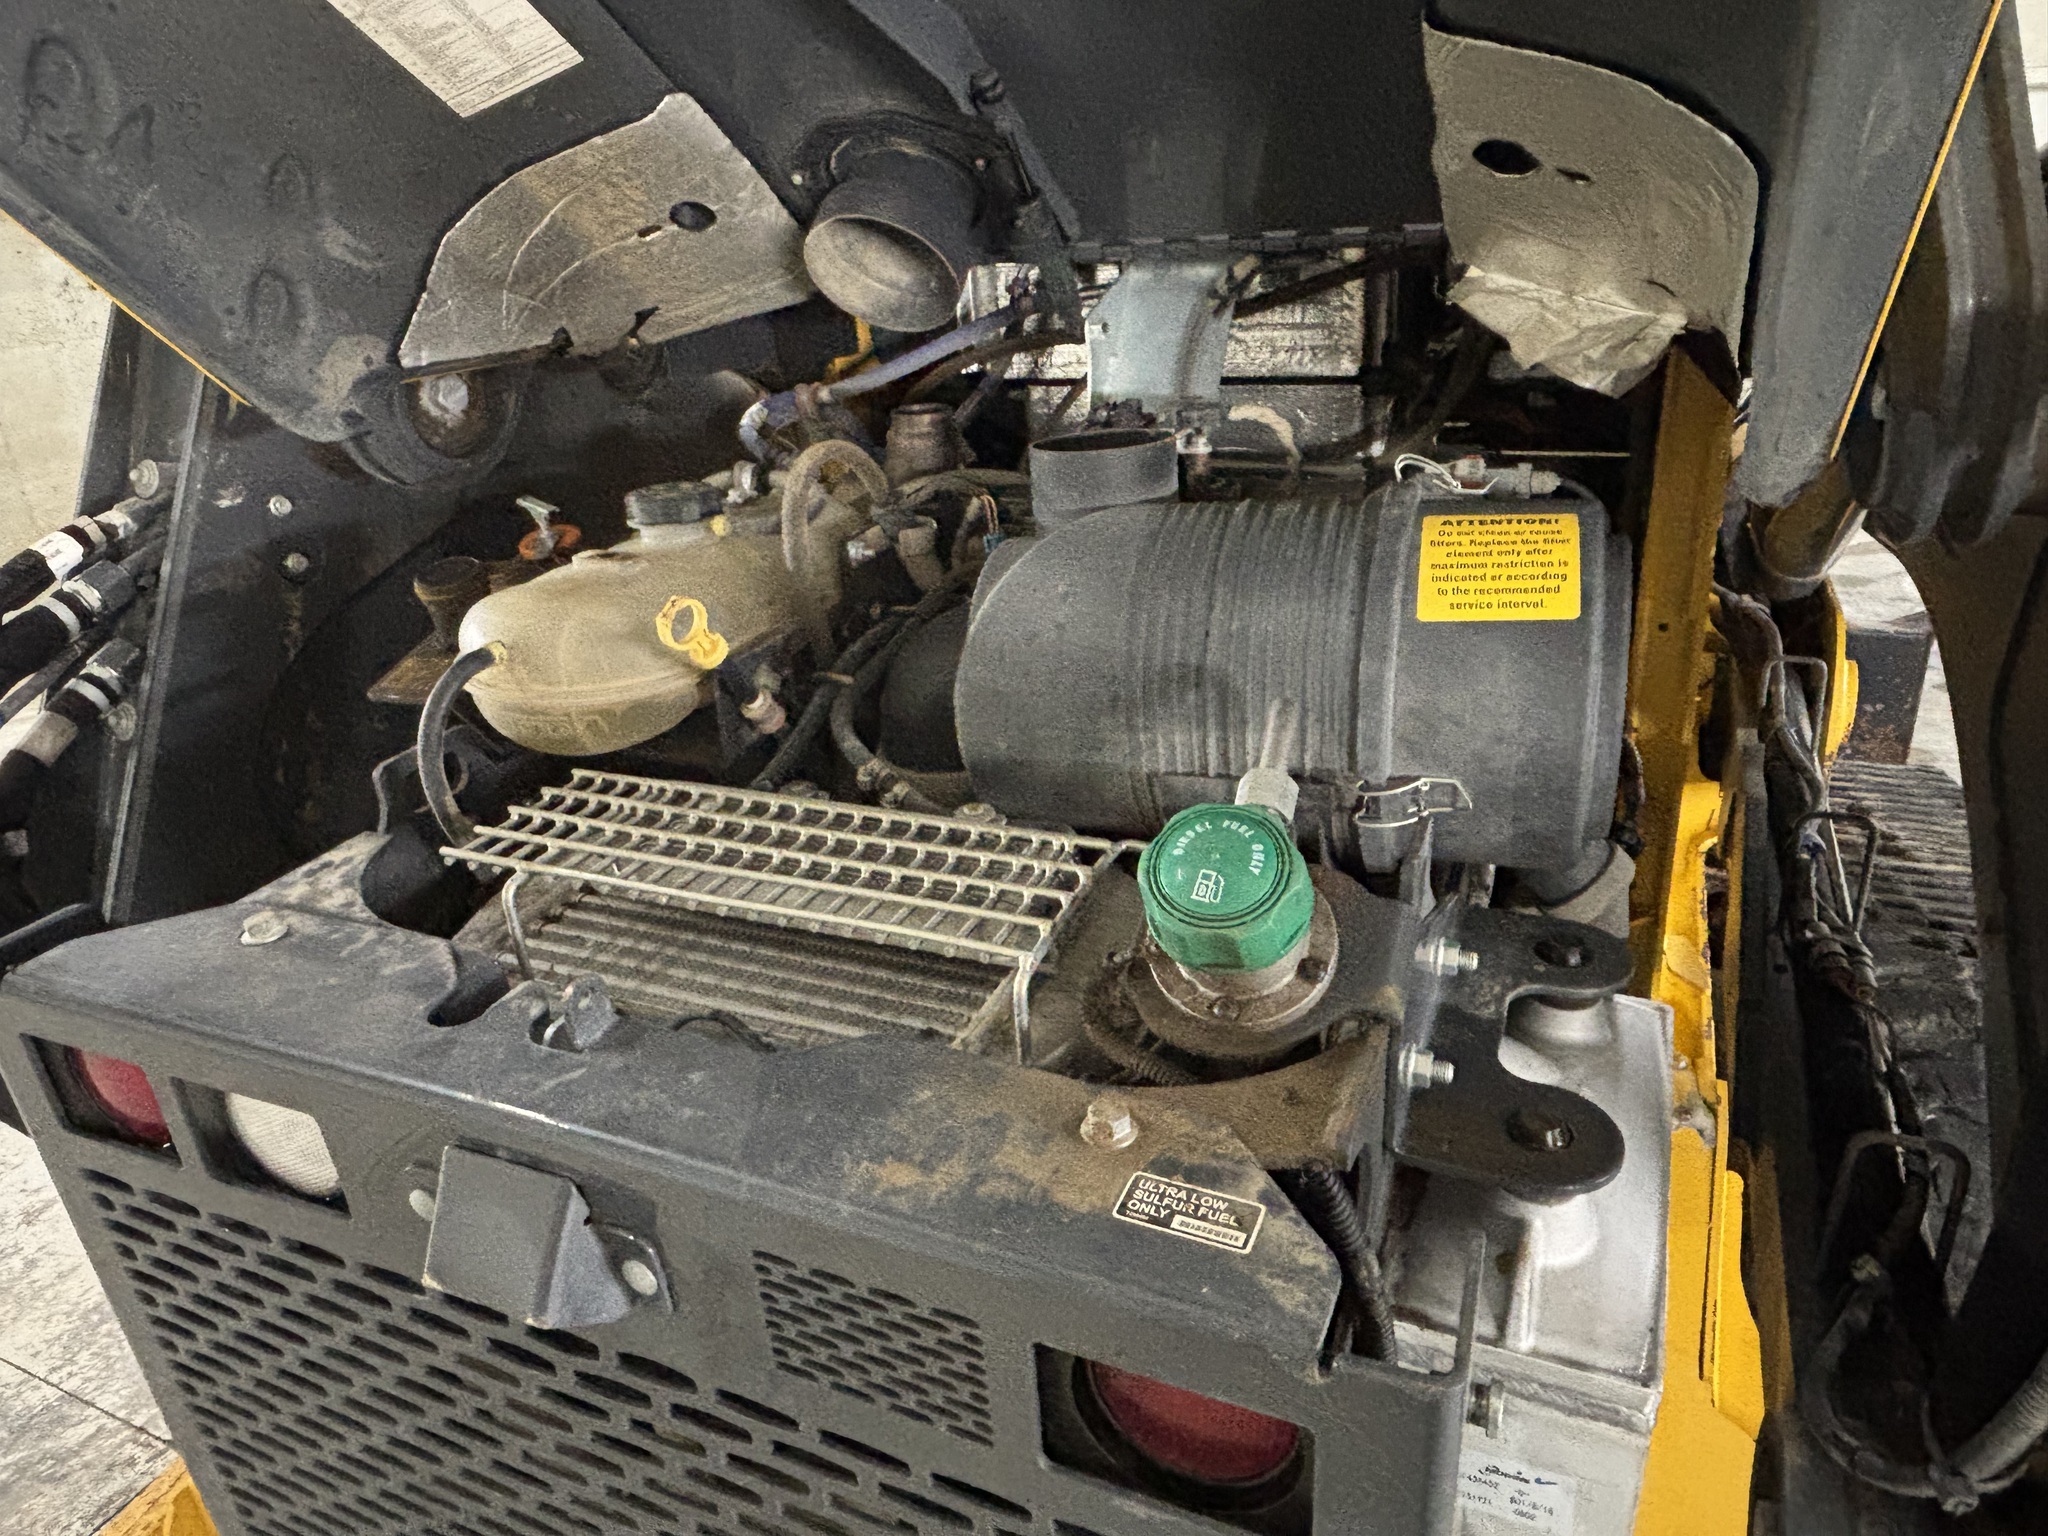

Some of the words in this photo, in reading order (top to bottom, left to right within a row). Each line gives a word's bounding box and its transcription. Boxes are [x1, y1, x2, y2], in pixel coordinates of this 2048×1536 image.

[1446, 550, 1494, 558] element
[1497, 549, 1522, 558] only
[1525, 548, 1553, 556] after
[1430, 561, 1488, 570] maximum
[1491, 559, 1555, 569] restriction
[1558, 559, 1569, 568] is
[1431, 573, 1487, 582] indicated
[1490, 573, 1502, 582] or
[1506, 572, 1568, 582] according
[1437, 587, 1448, 596] to
[1451, 586, 1470, 595] the
[1473, 584, 1561, 595] recommended
[1449, 599, 1494, 610] service
[1172, 821, 1213, 856] DIESEL
[1222, 819, 1255, 839] FUEL
[1248, 843, 1266, 876] ONLY
[1138, 1178, 1187, 1201] ULTRA
[1190, 1193, 1229, 1211] LOW
[1127, 1199, 1171, 1219] ONLY
[1132, 1189, 1195, 1215] SULFUR
[1197, 1206, 1242, 1228] FUEL
